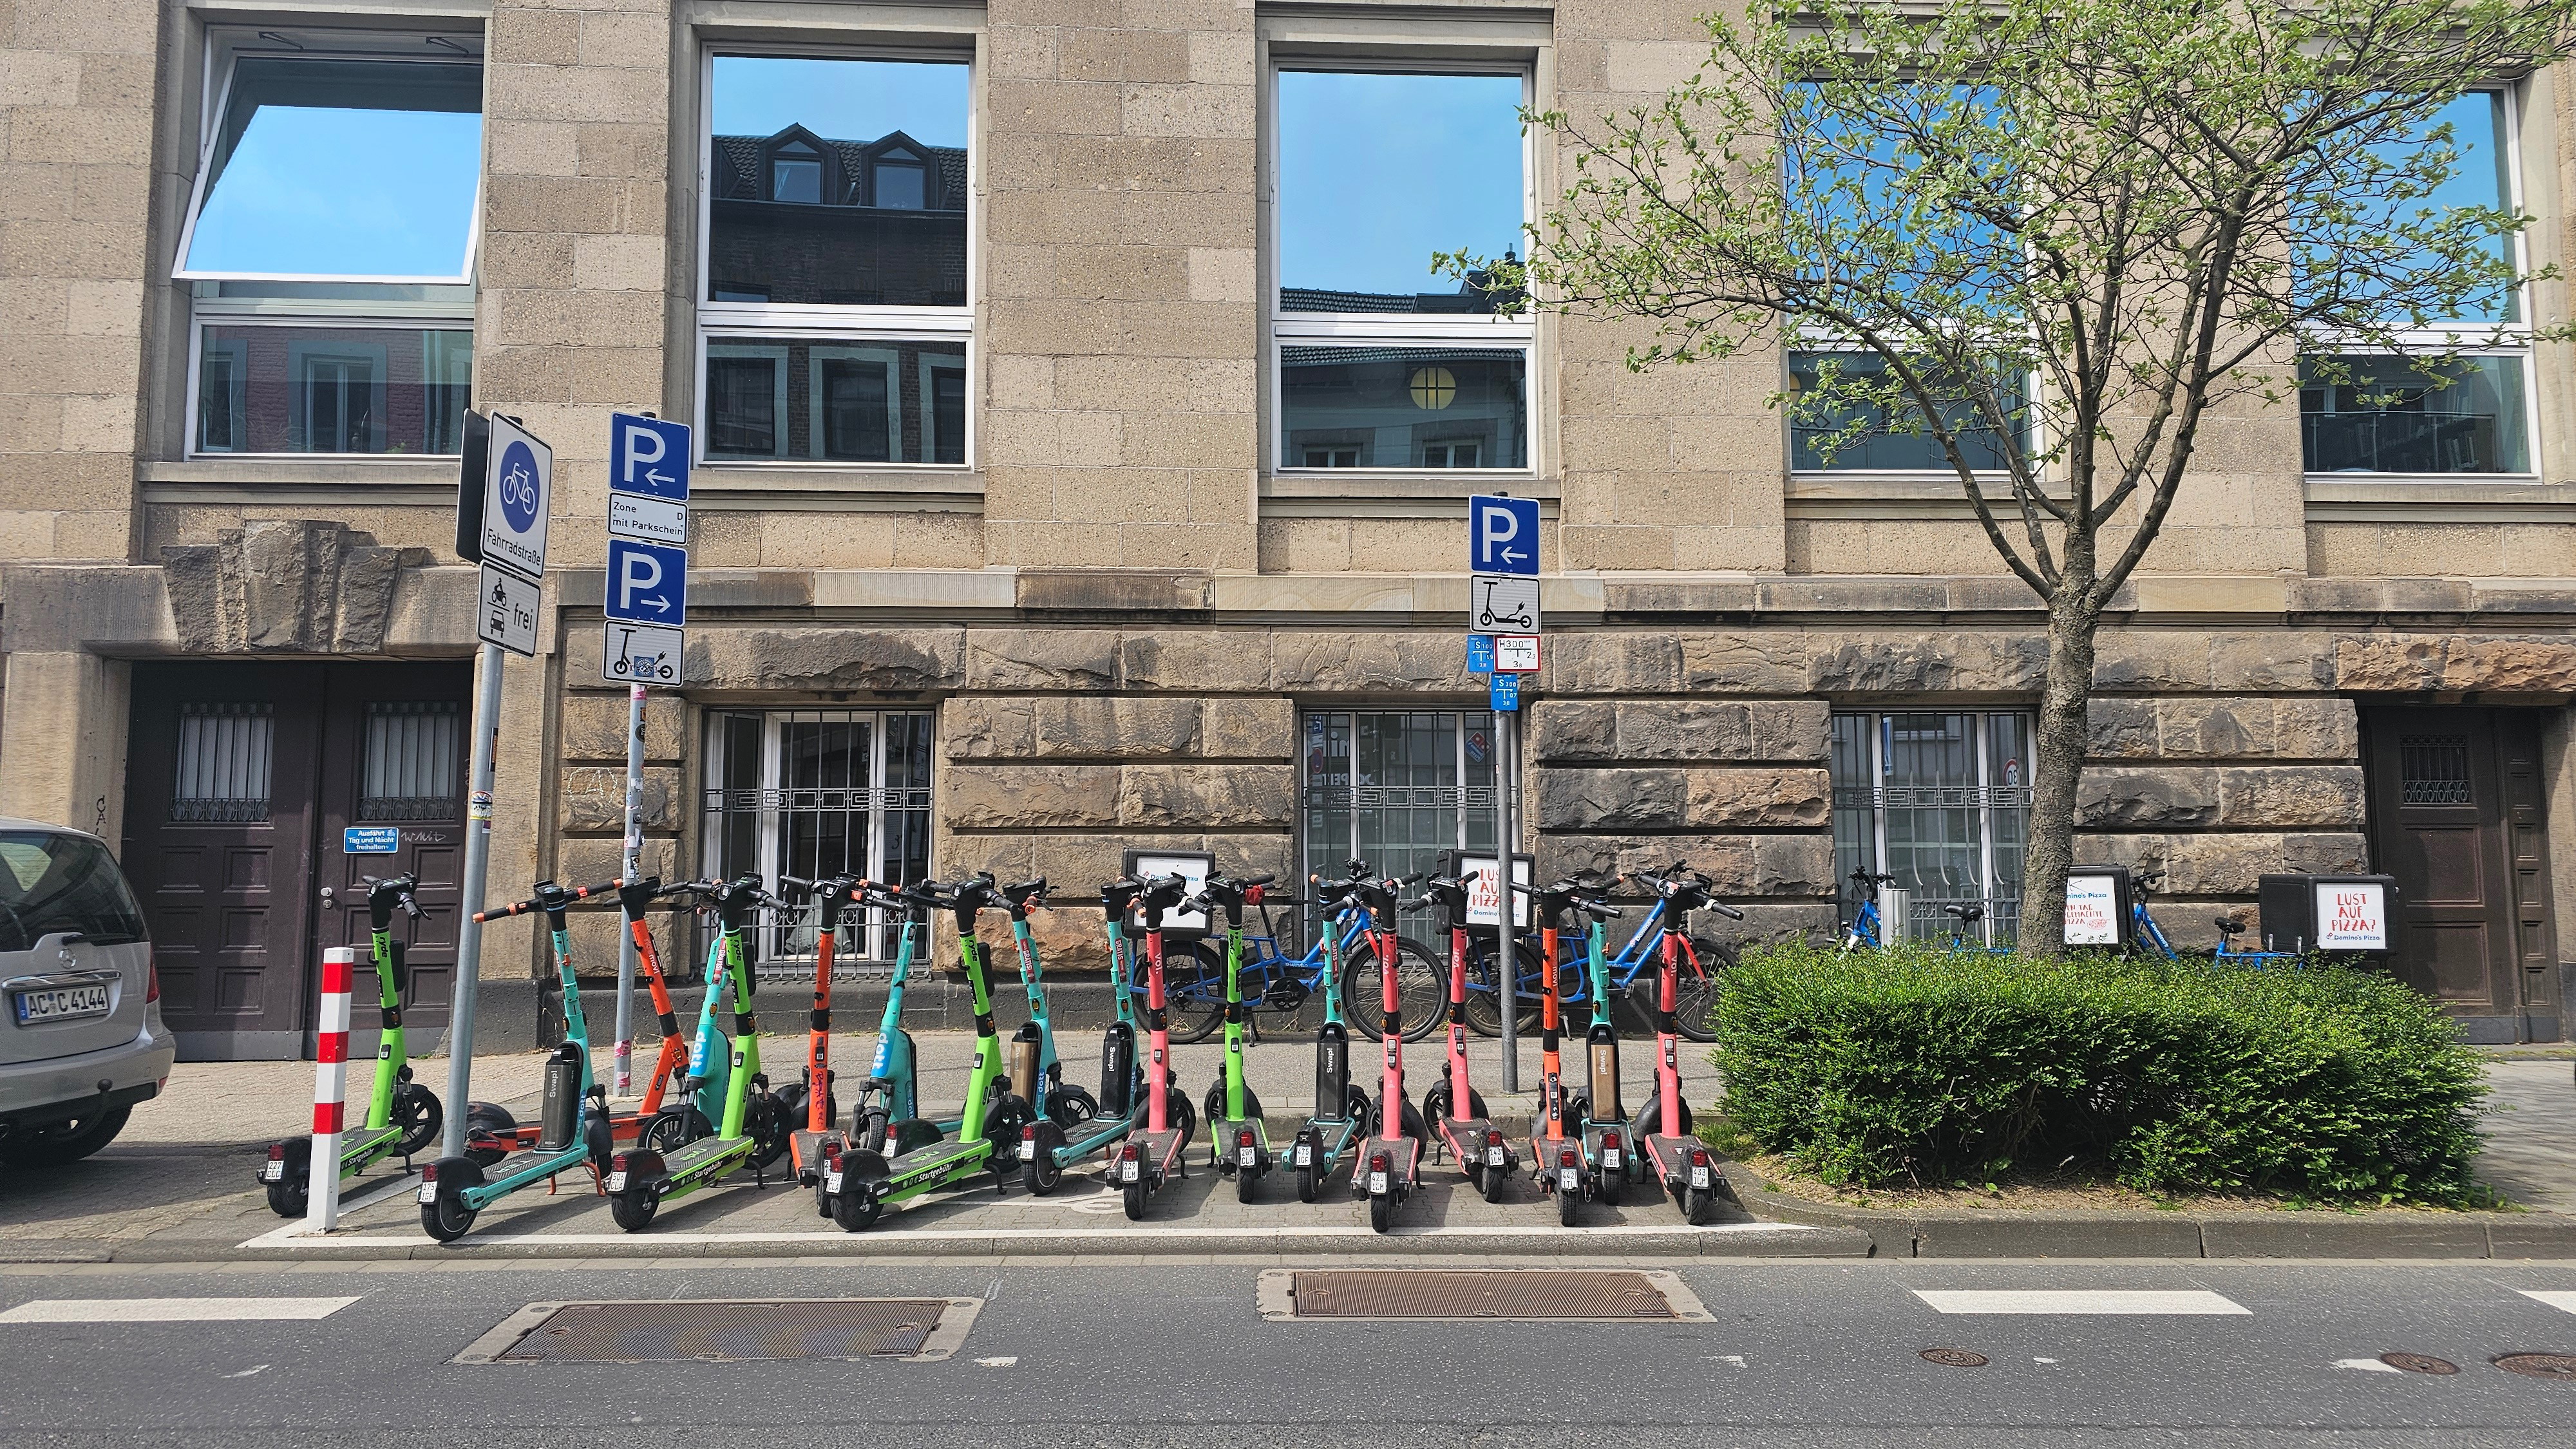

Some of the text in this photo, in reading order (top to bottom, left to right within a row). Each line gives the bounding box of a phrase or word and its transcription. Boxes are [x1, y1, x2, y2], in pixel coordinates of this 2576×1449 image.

[623, 424, 666, 482] P
[613, 502, 636, 513] Zone
[612, 518, 683, 536] mit Parkschein
[1482, 506, 1518, 562] P
[487, 528, 541, 567] Fahrradstraße
[620, 551, 661, 609] P
[514, 603, 534, 631] frei
[1480, 882, 1498, 894] AU
[2337, 893, 2367, 905] LUST
[2338, 906, 2362, 918] AUF
[2331, 919, 2376, 932] PIZZA?
[379, 936, 388, 958] ryde
[969, 940, 978, 961] ryde
[29, 989, 105, 1016] AC C 4144
[690, 1031, 706, 1069] dott
[872, 1032, 888, 1070] dott
[694, 1160, 723, 1180] Startgebühr
[918, 1163, 953, 1182] Startgebühr
[828, 1182, 838, 1191] CLA
